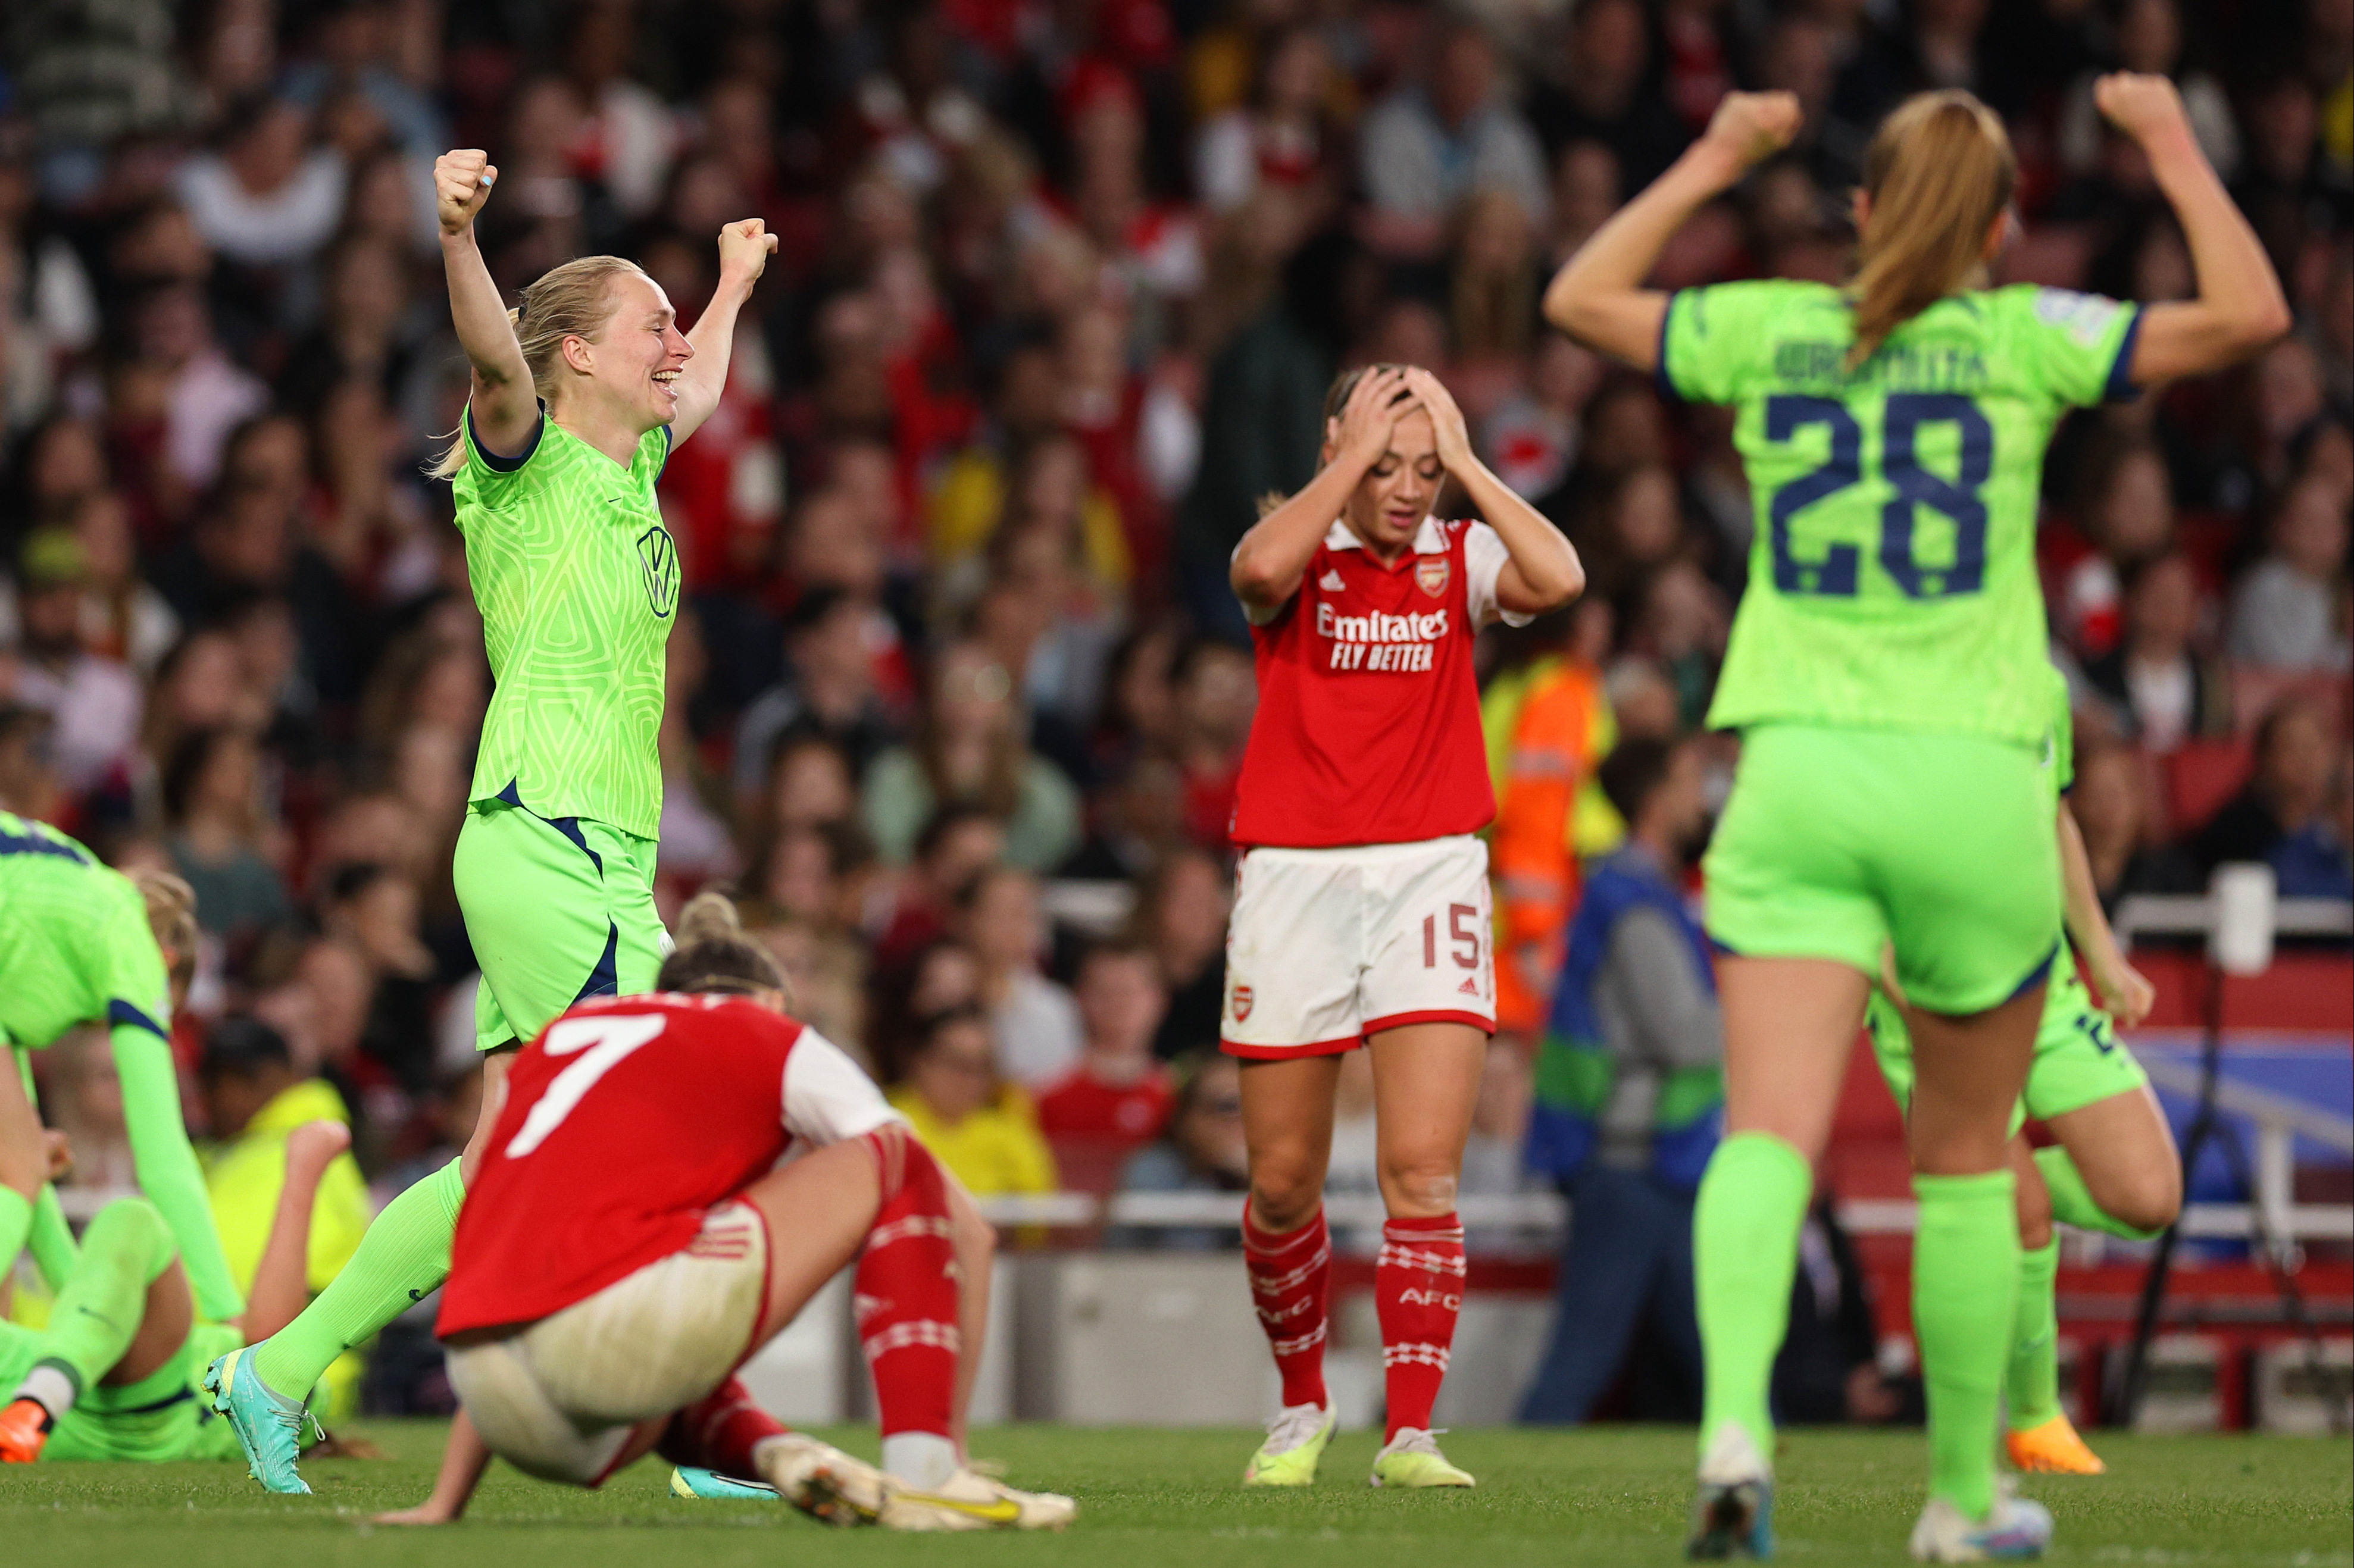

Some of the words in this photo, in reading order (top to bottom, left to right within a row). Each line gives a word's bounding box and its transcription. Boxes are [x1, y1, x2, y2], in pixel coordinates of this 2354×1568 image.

[1766, 393, 1992, 596] 28
[1317, 602, 1449, 643] Emirates
[1330, 641, 1367, 670] FLY
[1367, 643, 1434, 672] BETTER
[1423, 903, 1478, 969] 15
[505, 1013, 668, 1159] 7
[1399, 1287, 1462, 1312] AFC
